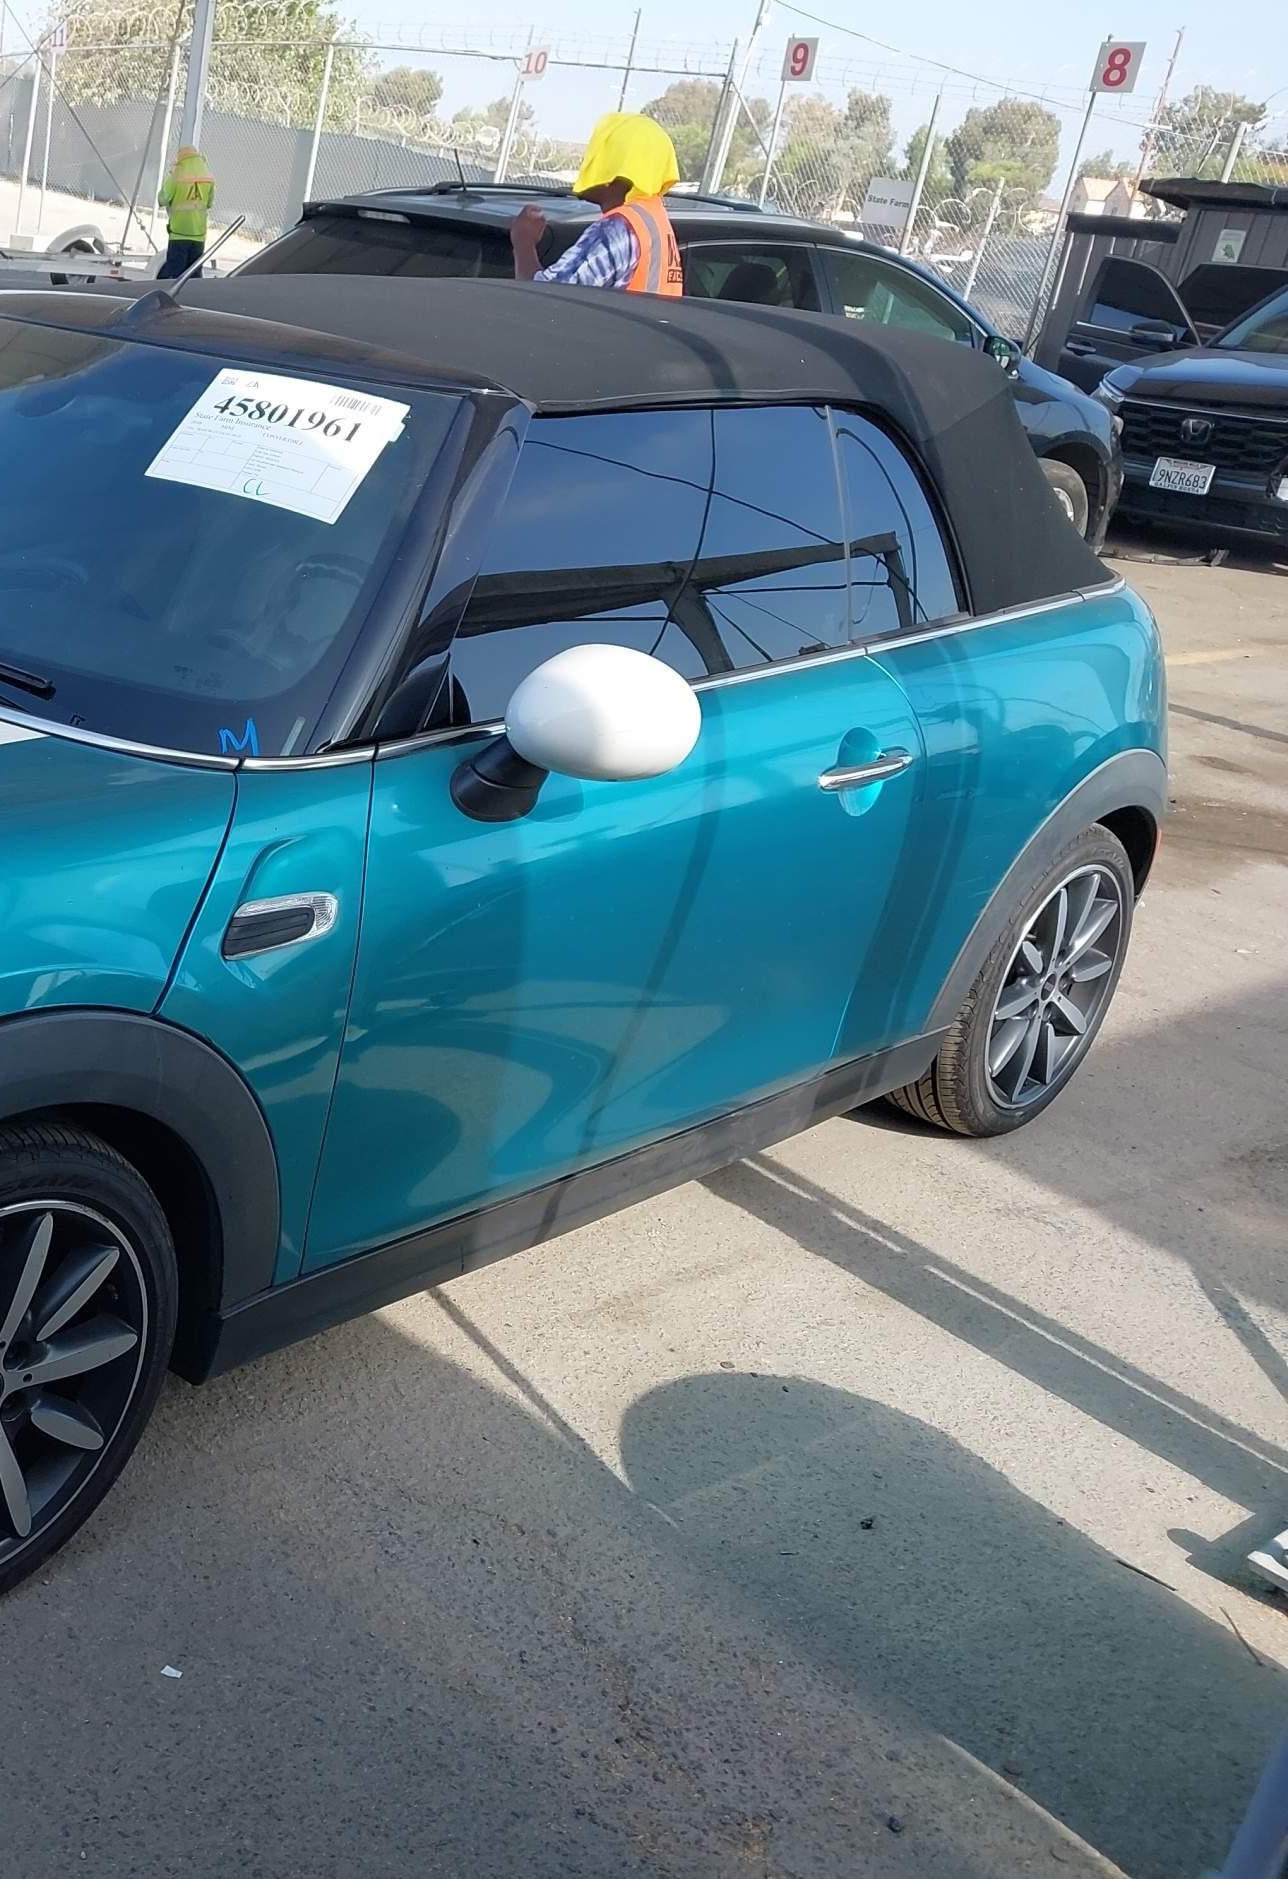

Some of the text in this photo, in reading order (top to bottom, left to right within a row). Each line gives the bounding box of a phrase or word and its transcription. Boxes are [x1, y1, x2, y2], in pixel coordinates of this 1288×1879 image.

[522, 51, 547, 74] 10
[790, 43, 809, 75] 9
[1102, 48, 1131, 86] 8
[867, 194, 910, 208] State Farm
[214, 395, 362, 442] 45801961
[214, 414, 234, 424] Farm
[235, 418, 272, 431] Insurance
[1158, 469, 1207, 489] 9NZR683
[218, 717, 260, 757] M
